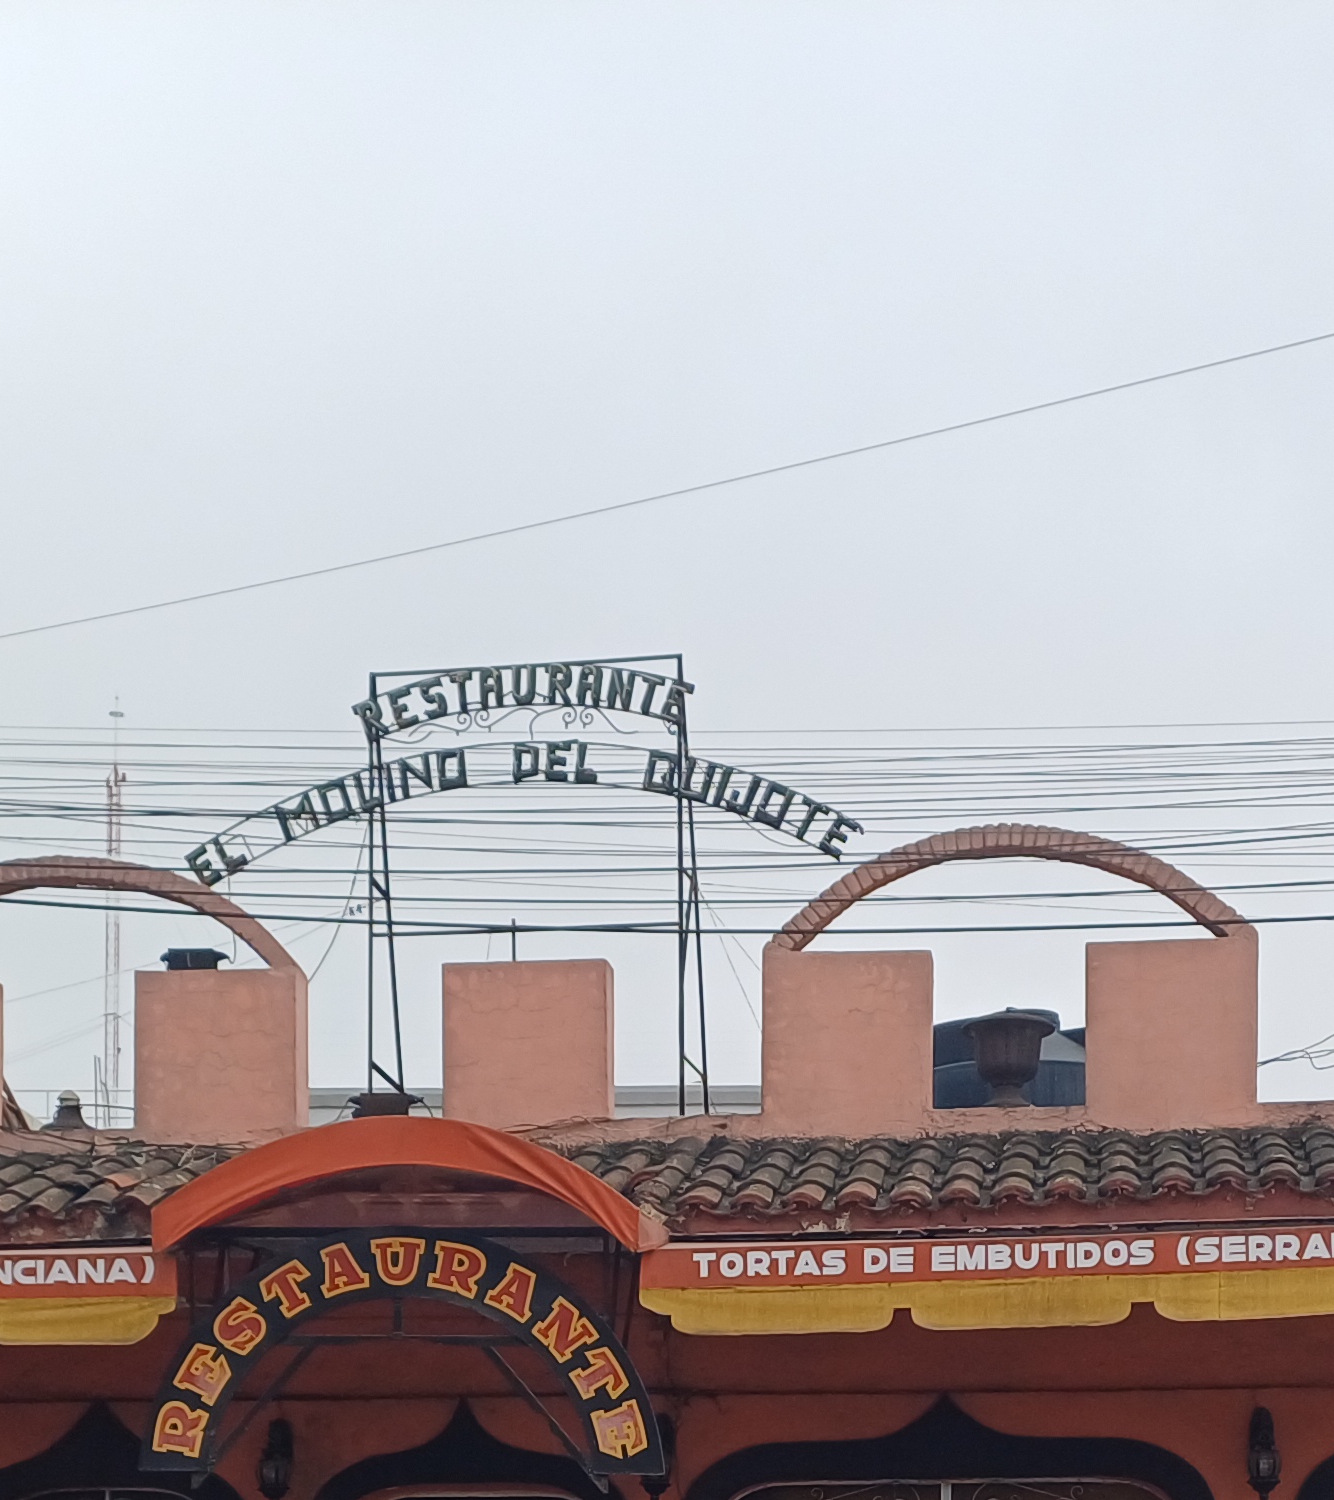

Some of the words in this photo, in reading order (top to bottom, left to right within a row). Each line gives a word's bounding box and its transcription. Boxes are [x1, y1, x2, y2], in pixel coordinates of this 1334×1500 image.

[351, 663, 695, 738] RESTAURANTE
[184, 836, 248, 886] EL
[274, 748, 467, 842] MOLINO
[512, 739, 598, 784] DEL
[642, 749, 864, 862] QUIJOTE
[692, 1249, 847, 1279] TORTAS
[863, 1247, 915, 1275] DE
[930, 1238, 1155, 1273] EMBUTIDOS
[152, 1237, 648, 1459] RESTAURANTE
